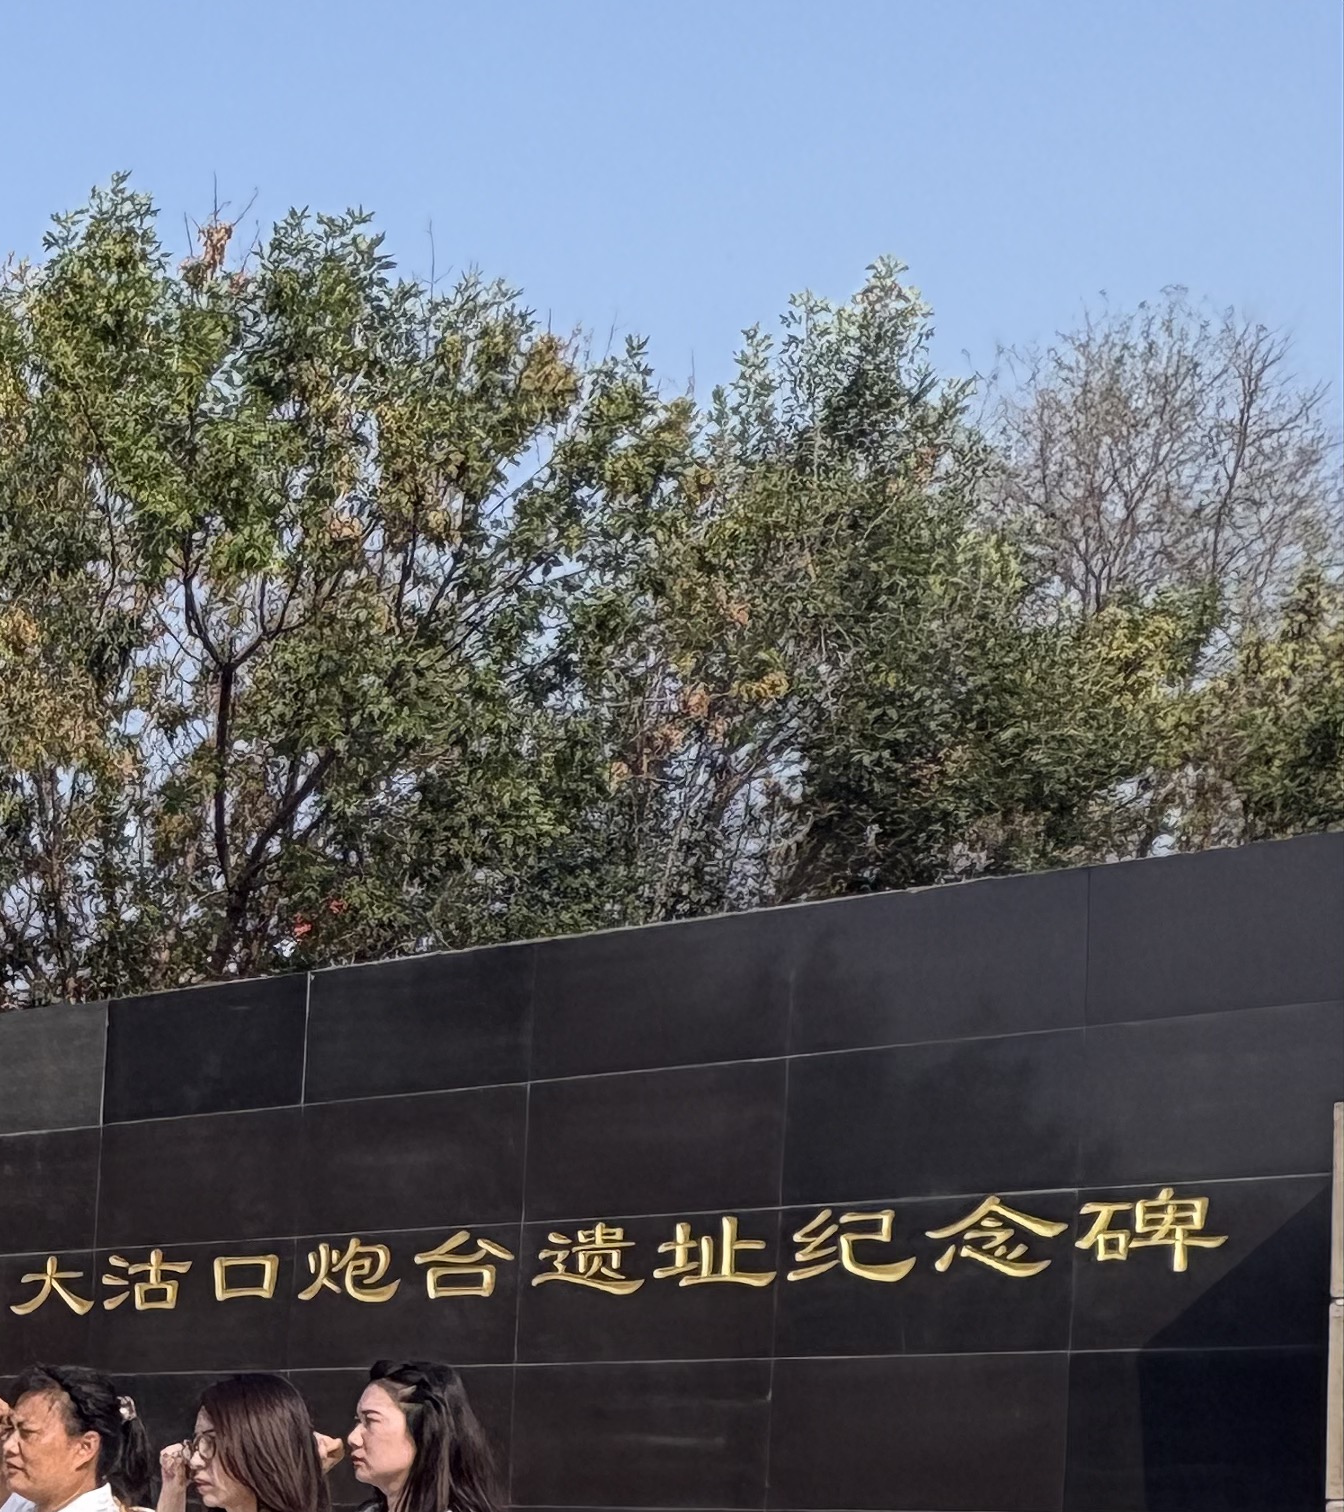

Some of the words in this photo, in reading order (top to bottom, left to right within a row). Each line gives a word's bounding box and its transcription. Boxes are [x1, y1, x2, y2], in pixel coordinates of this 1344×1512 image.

[9, 1186, 1228, 1317] 大沽口炮台遗址纪念碑
